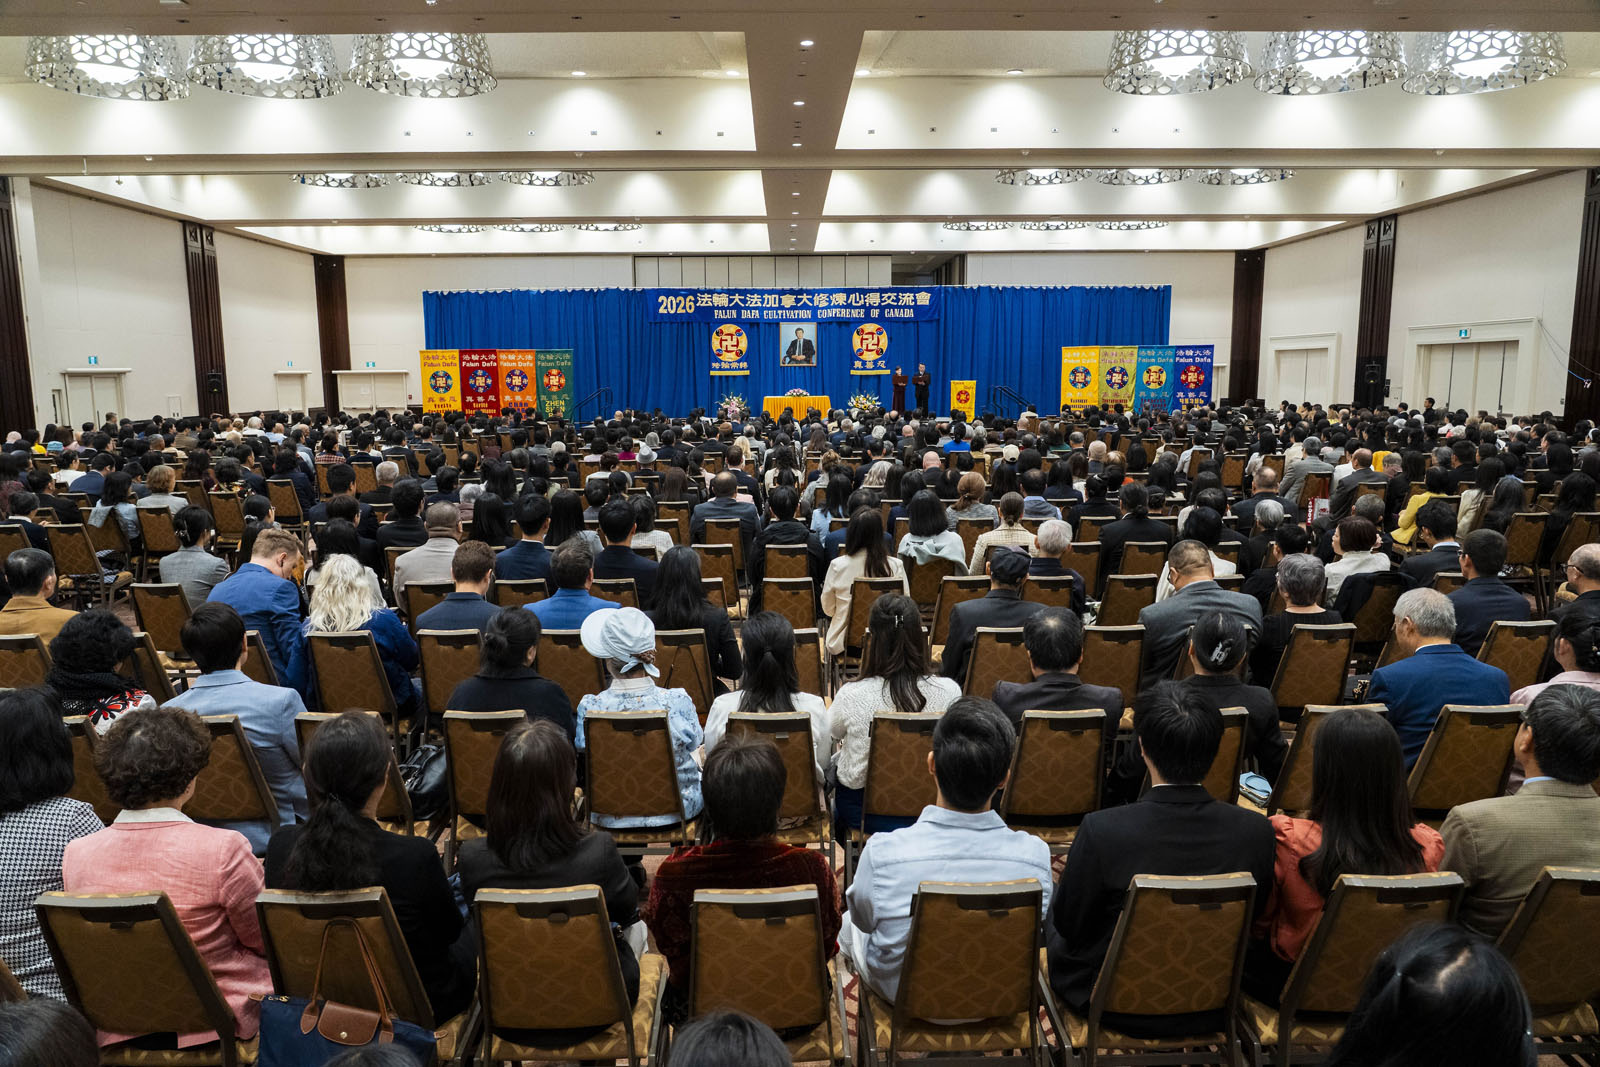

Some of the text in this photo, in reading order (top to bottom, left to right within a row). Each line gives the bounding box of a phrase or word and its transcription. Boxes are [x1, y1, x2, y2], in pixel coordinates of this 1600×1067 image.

[658, 291, 932, 314] 2026 法輪大法加拿大修煉心得交流會
[714, 308, 914, 319] FALUN DAFA CULTIVATION CONFERENCE OF CANADA
